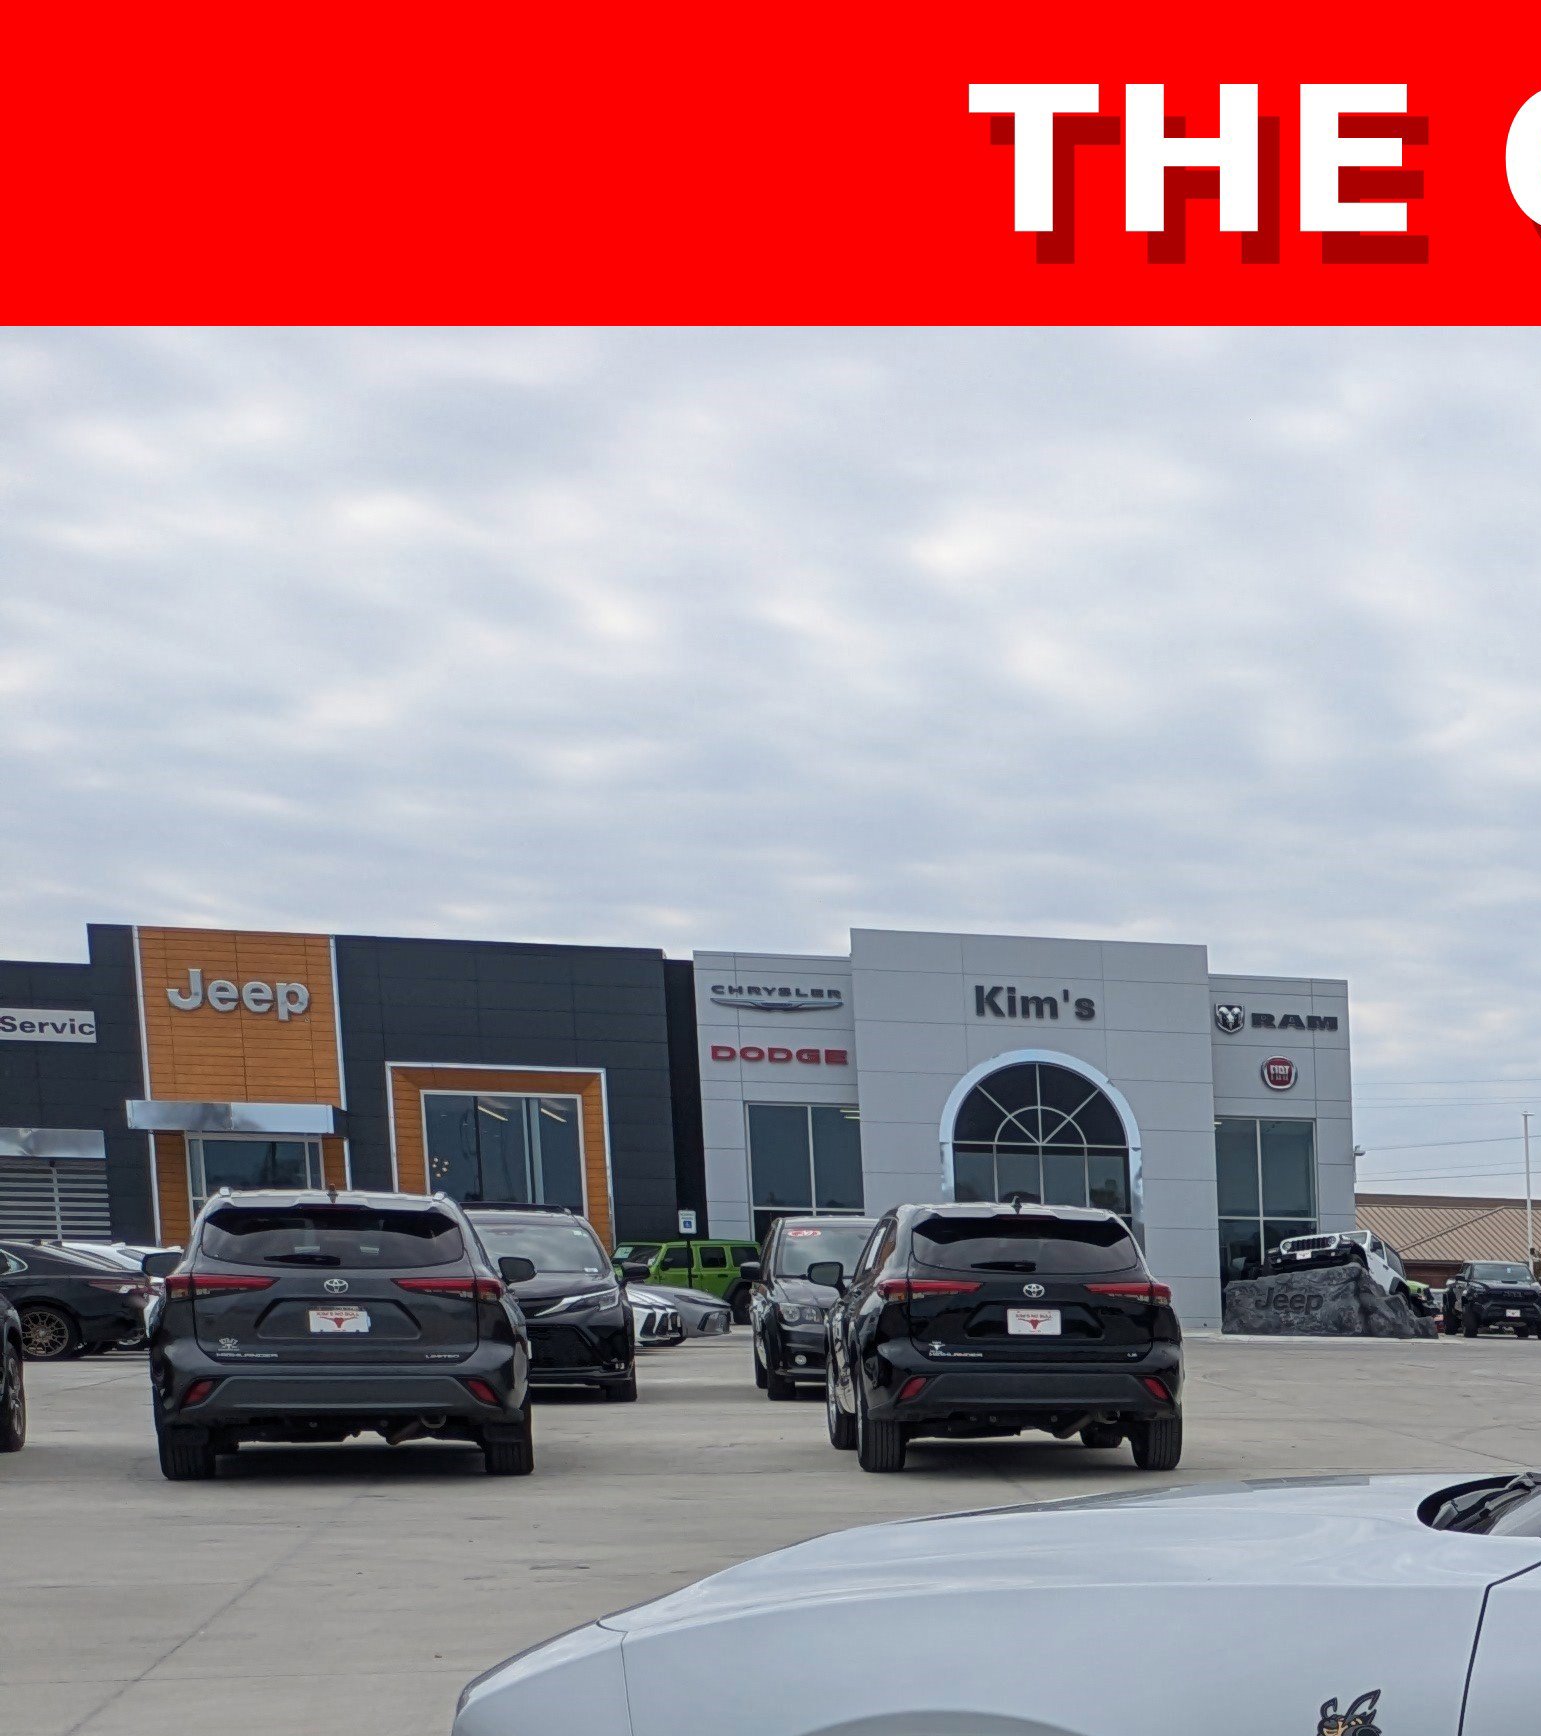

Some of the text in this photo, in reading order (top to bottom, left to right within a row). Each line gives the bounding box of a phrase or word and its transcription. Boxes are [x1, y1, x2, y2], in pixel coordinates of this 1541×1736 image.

[166, 968, 310, 1021] Jeep
[711, 985, 842, 998] CHRYSLER
[975, 985, 1095, 1019] Kim's
[0, 1015, 95, 1035] Servic
[1251, 1012, 1338, 1031] RAM
[711, 1045, 848, 1065] DODGE
[1255, 1287, 1323, 1315] Jeep
